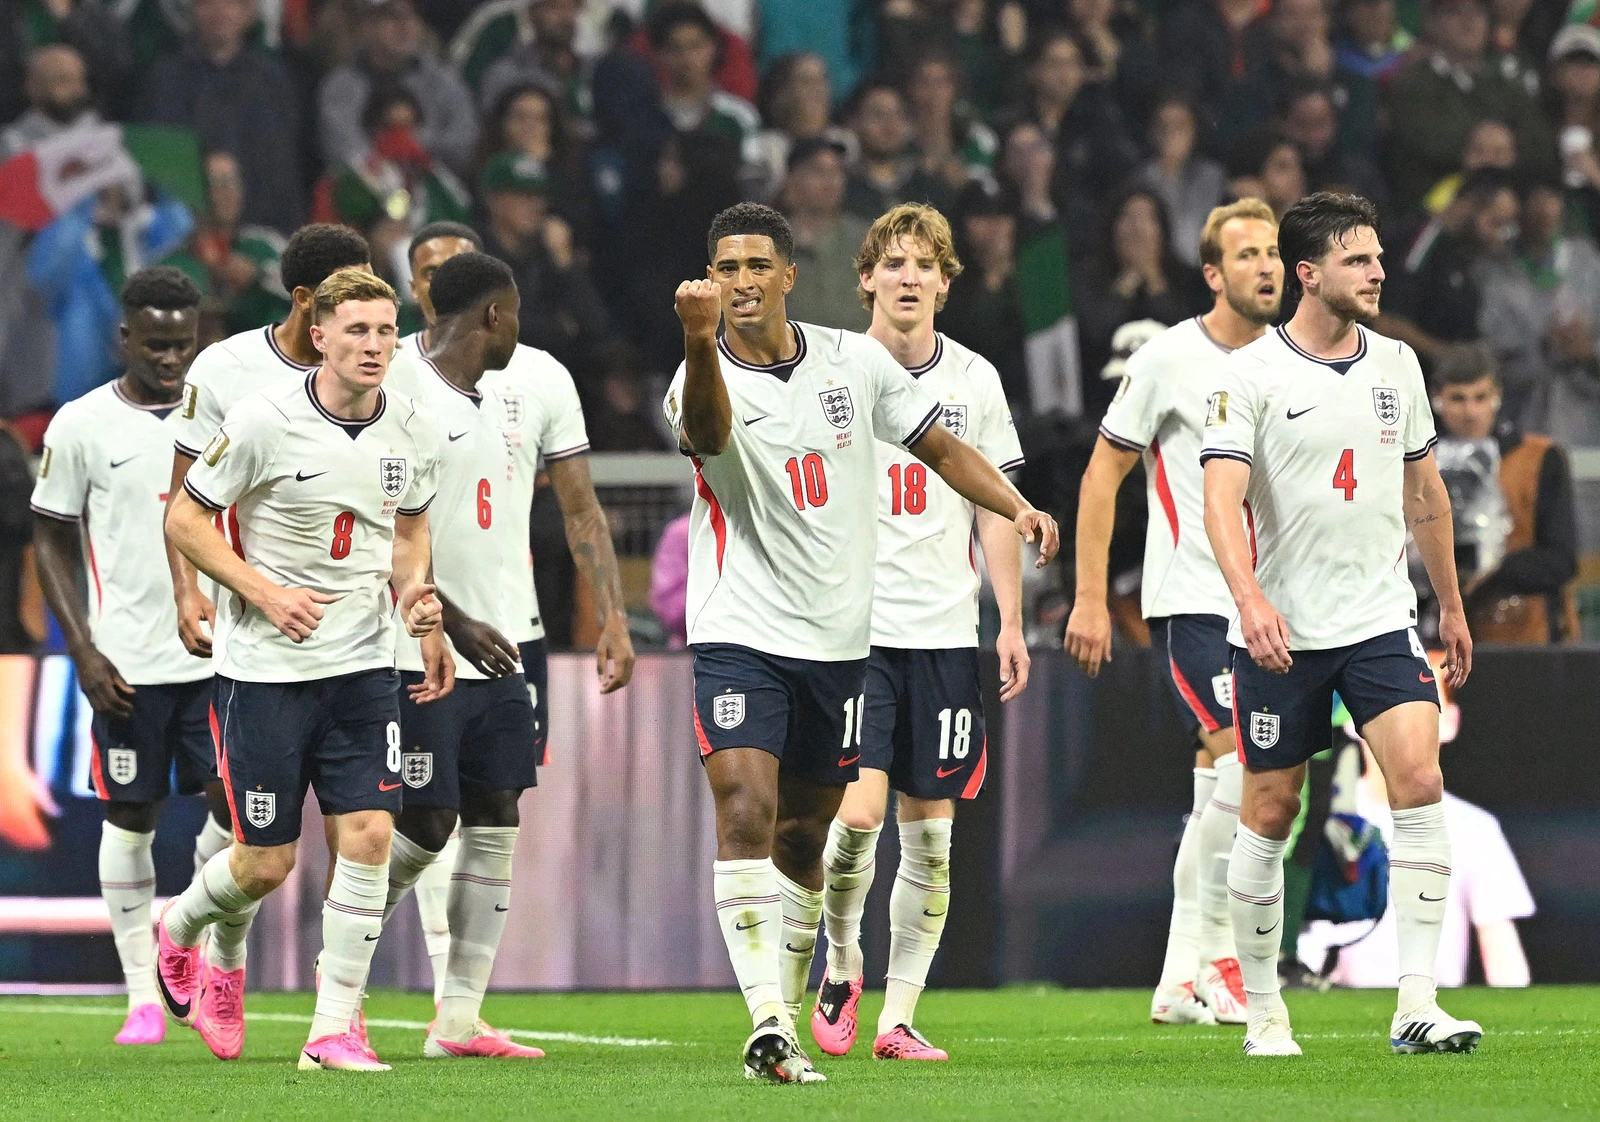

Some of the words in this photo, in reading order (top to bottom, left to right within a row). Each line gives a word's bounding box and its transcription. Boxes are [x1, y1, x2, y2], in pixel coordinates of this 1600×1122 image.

[785, 453, 828, 511] 10
[888, 463, 926, 515] 18
[1333, 449, 1357, 501] 4
[477, 478, 491, 530] 6
[330, 511, 355, 560] 8
[386, 721, 401, 773] 8
[938, 708, 972, 760] 18
